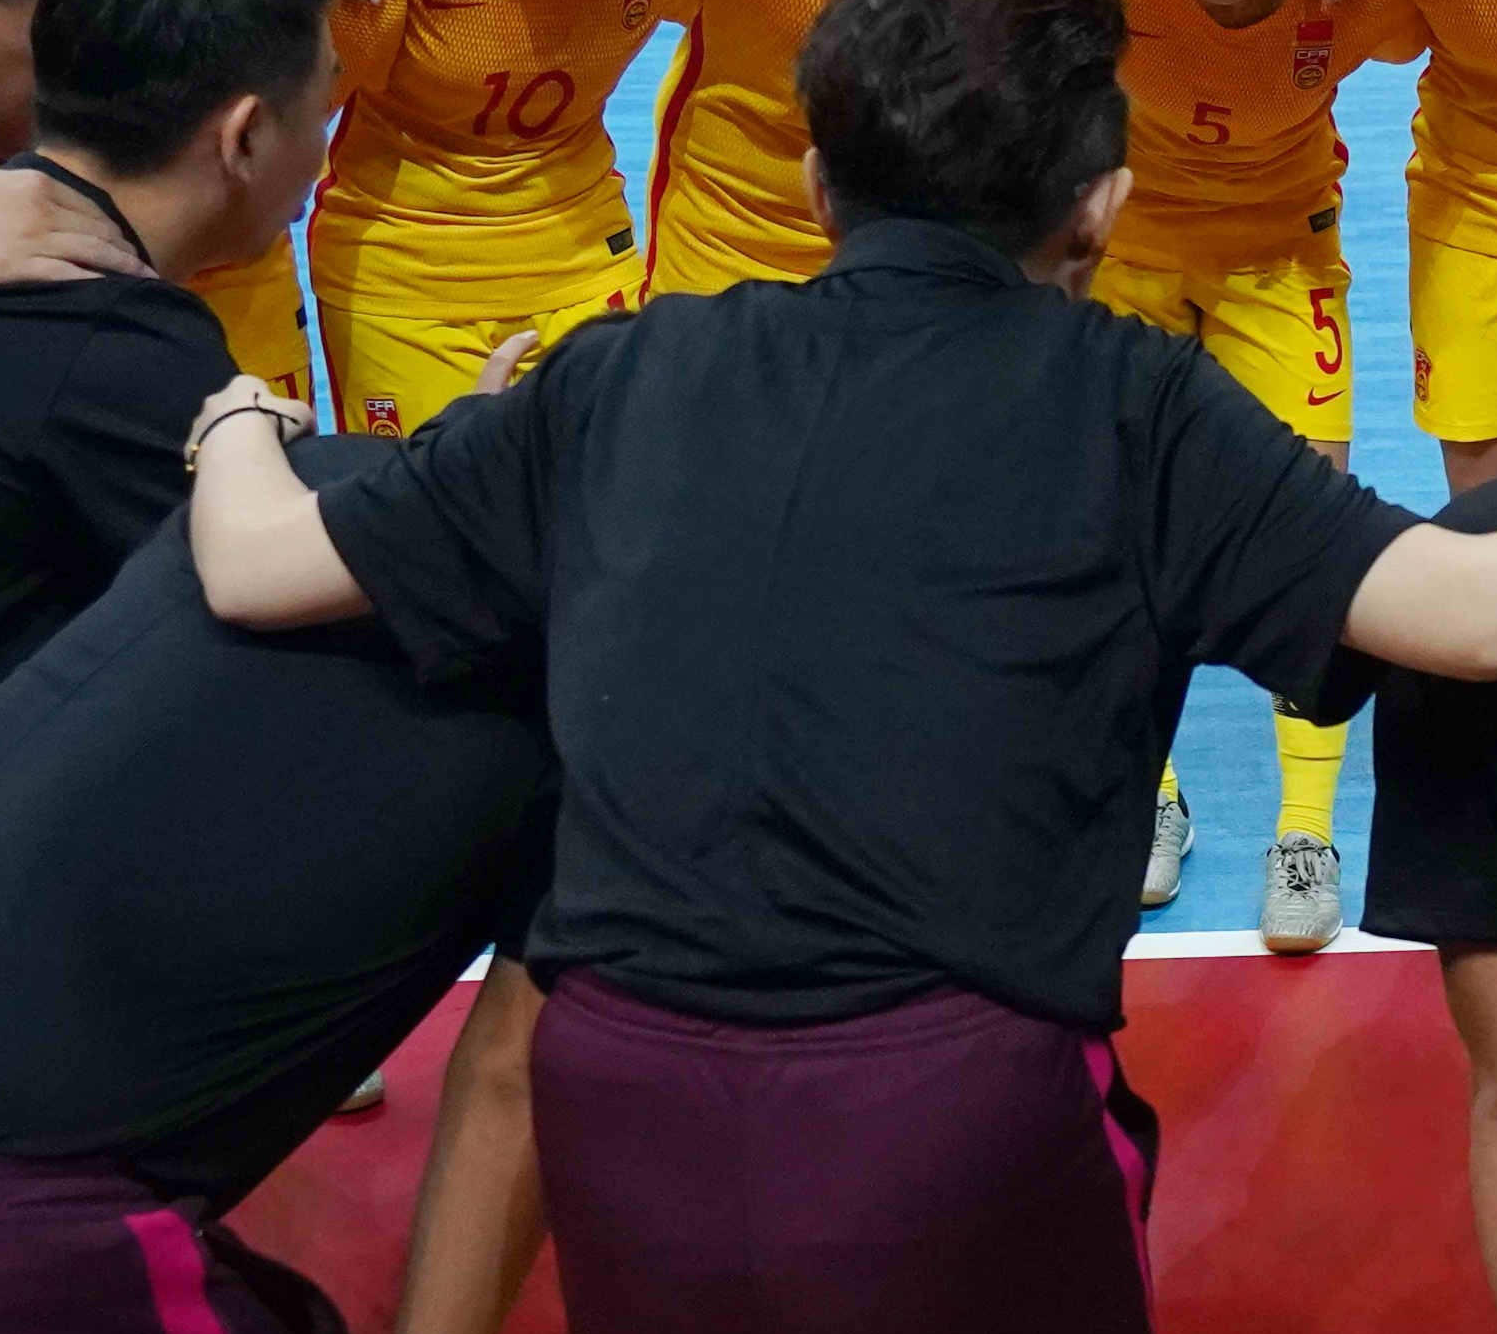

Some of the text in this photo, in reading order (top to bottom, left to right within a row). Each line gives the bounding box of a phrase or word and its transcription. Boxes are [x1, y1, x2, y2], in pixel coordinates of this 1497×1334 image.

[471, 68, 576, 140] 10
[1186, 101, 1233, 146] 5
[1307, 287, 1343, 376] 5
[365, 399, 396, 413] CFA
